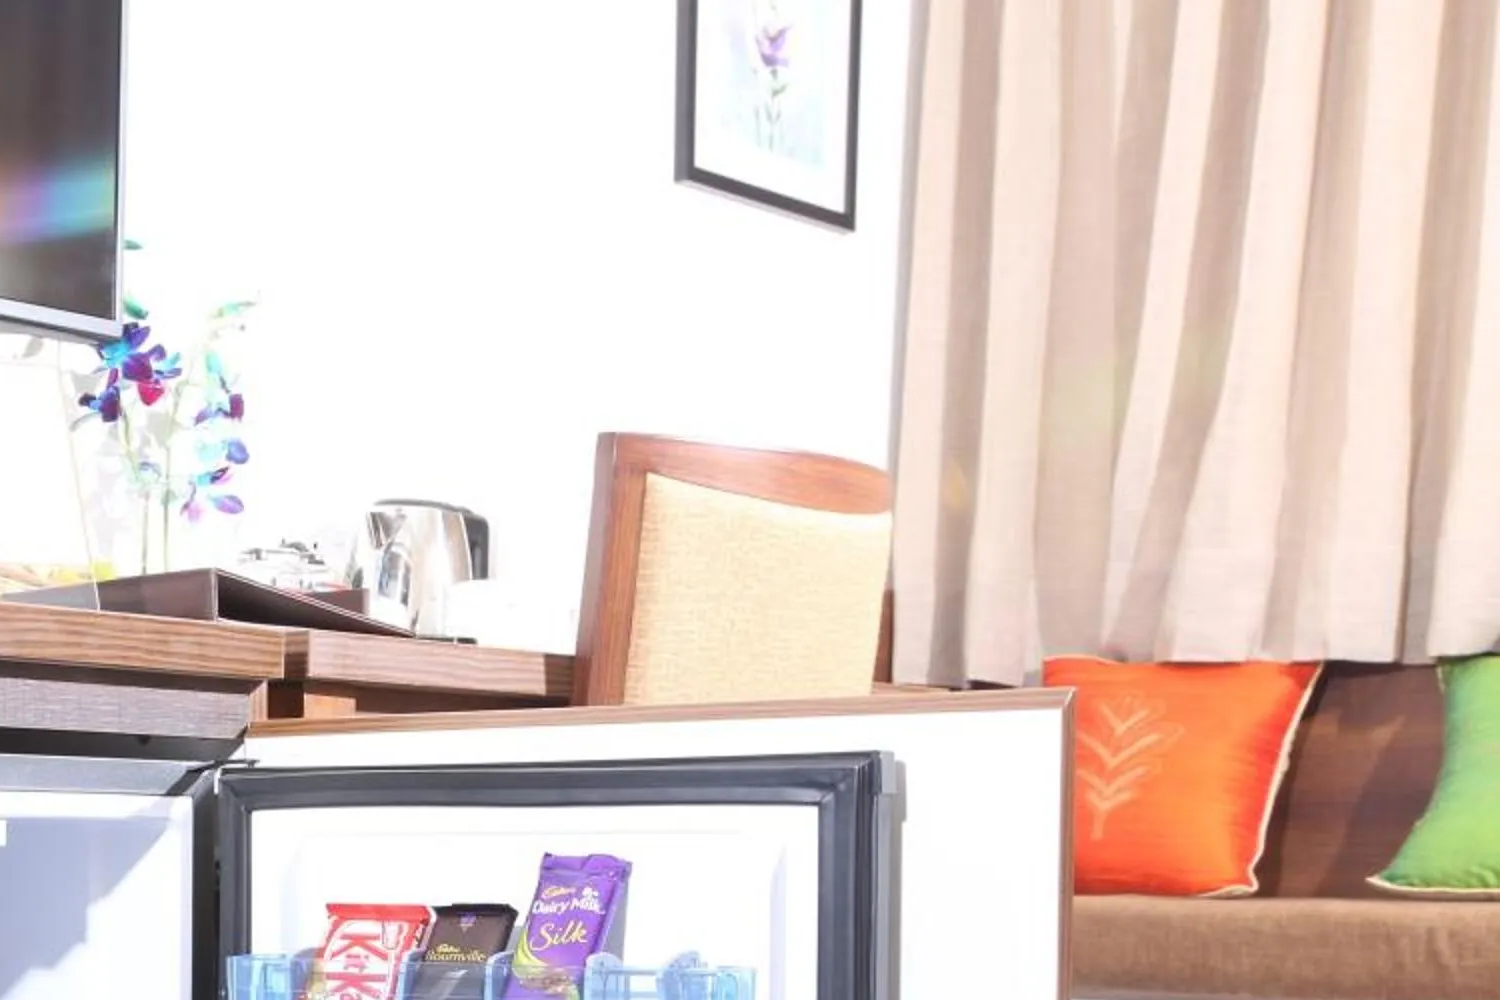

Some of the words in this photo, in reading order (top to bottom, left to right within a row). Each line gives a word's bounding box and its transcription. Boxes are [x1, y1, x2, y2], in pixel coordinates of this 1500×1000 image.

[532, 898, 571, 916] Dairy
[571, 895, 607, 914] Milk
[529, 919, 588, 951] Silk
